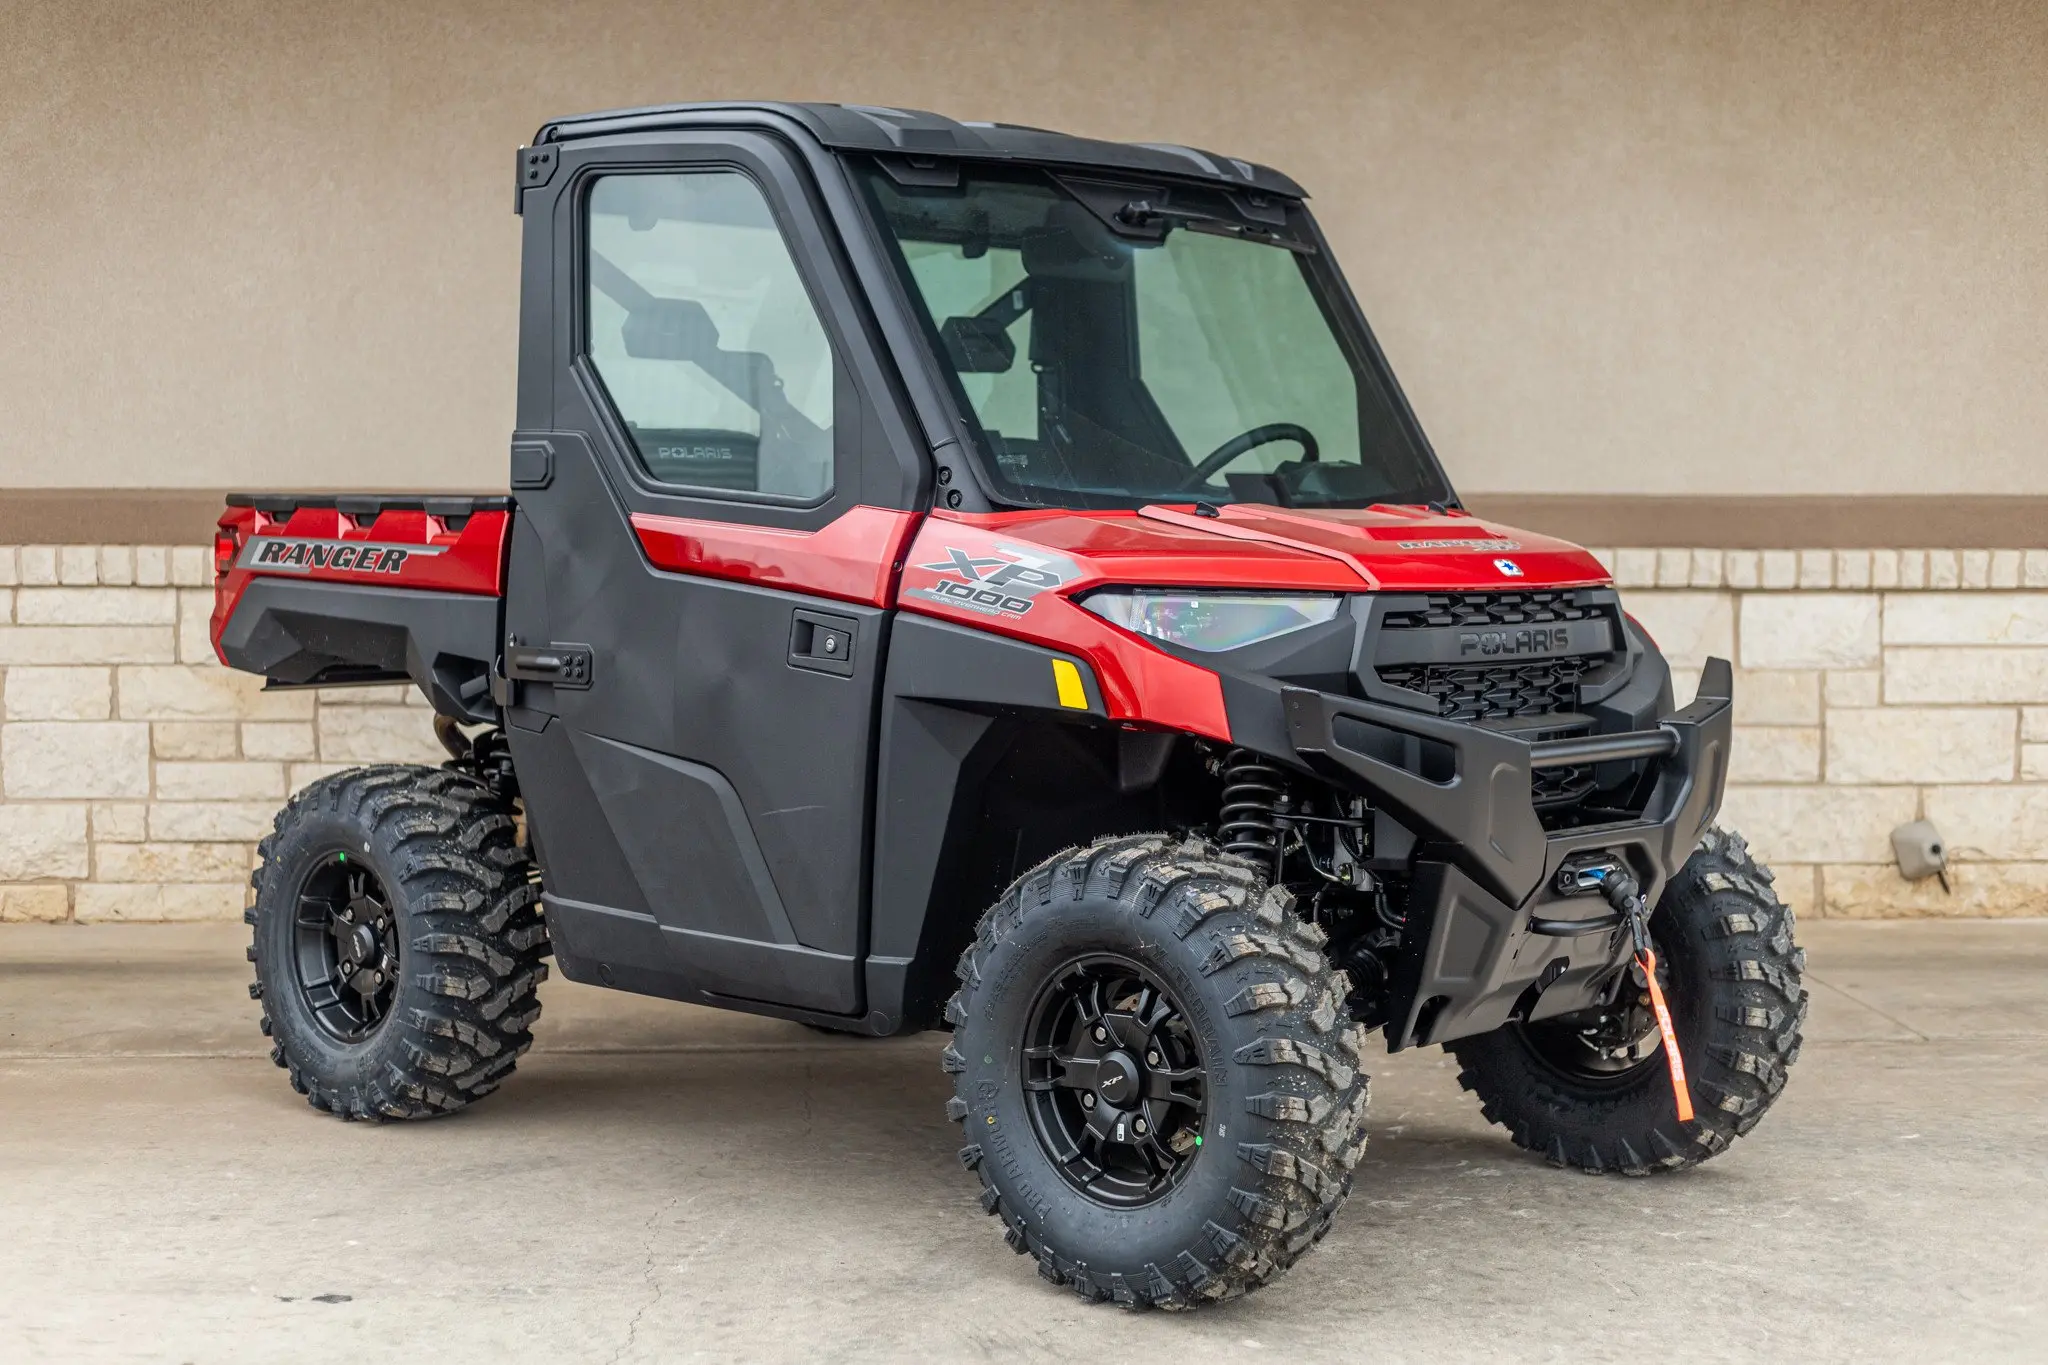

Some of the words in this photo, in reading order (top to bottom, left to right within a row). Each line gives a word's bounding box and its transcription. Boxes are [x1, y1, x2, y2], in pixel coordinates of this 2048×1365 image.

[658, 447, 733, 460] POLARIS
[257, 540, 409, 574] RANGER
[914, 545, 1063, 589] XP
[931, 594, 953, 605] DUAL
[1001, 611, 1023, 621] CAM
[935, 580, 1034, 614] 1000
[1459, 628, 1569, 656] POLARIS
[1655, 1004, 1685, 1083] POLARIS
[1101, 1075, 1124, 1089] XP
